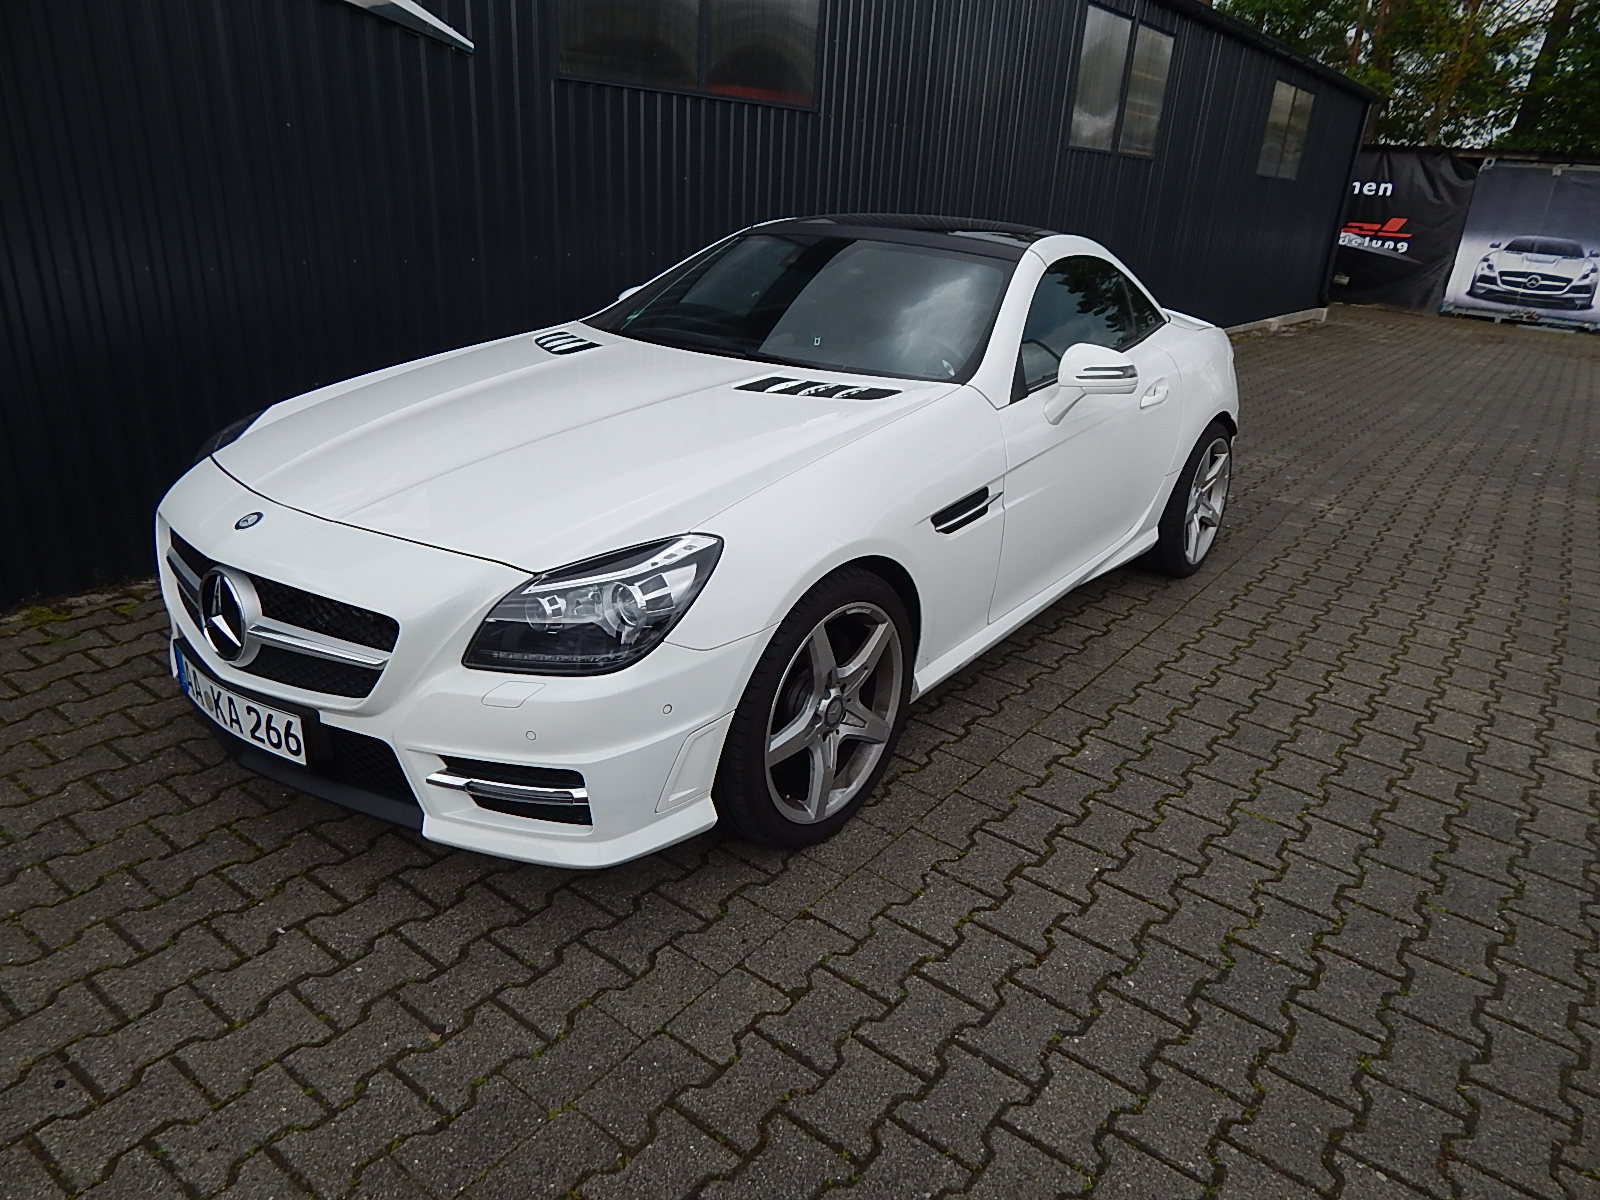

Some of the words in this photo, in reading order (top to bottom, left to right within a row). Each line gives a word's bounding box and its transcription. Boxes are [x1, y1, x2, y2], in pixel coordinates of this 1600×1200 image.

[184, 661, 205, 707] AA
[211, 686, 244, 734] KA
[246, 705, 302, 757] 266
